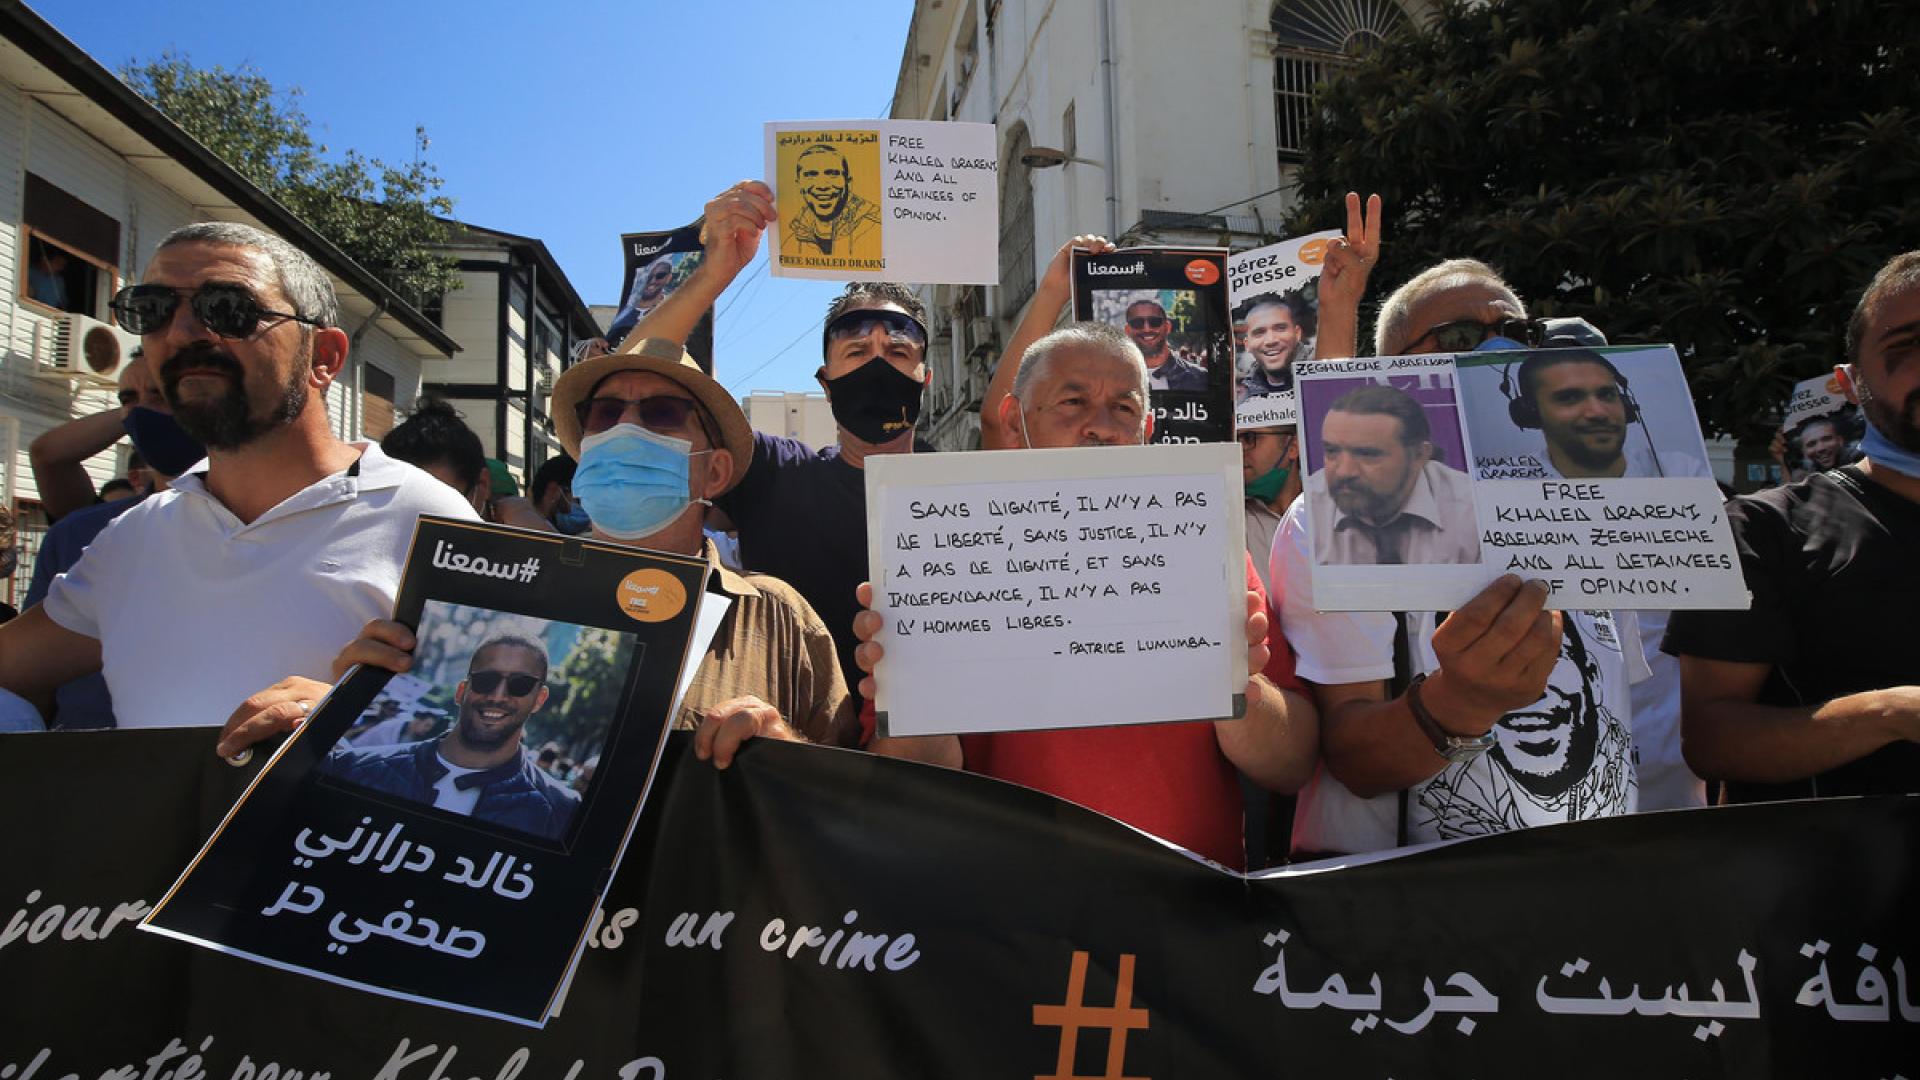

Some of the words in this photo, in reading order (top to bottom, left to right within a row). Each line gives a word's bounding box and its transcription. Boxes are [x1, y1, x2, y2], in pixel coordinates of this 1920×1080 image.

[889, 134, 925, 149] FREE
[888, 152, 945, 168] KHALED
[894, 169, 925, 183] AND
[931, 172, 958, 185] ALL
[888, 186, 954, 202] DETAINEES
[961, 192, 977, 202] OF
[893, 206, 947, 221] OPINION.
[778, 254, 804, 265] FREE
[805, 256, 846, 267] KHALED
[1231, 265, 1297, 293] presse
[1296, 360, 1382, 376] ZEGHILECHE
[1172, 401, 1209, 421] خالد
[1790, 396, 1831, 413] resse
[1475, 453, 1543, 469] KHALED
[1542, 482, 1605, 501] FREE
[909, 500, 971, 520] SANS
[988, 491, 1070, 519] DIGNITÉ,
[1076, 495, 1099, 513] IL
[1104, 493, 1142, 511] N'Y
[1145, 493, 1163, 509] A
[1174, 491, 1208, 508] PAS
[1495, 505, 1591, 523] KHALED
[896, 533, 921, 551] DE
[934, 525, 1015, 552] LIBERTÉ,
[1023, 528, 1068, 544] SANS
[1078, 526, 1145, 544] JUSTICE,
[1147, 522, 1170, 539] IL
[1173, 521, 1208, 536] N'Y
[1482, 529, 1580, 547] ABDELKRIM
[1590, 528, 1715, 548] ZEGHILECHE
[431, 539, 541, 584] #سمعنا
[896, 563, 912, 578] A
[922, 561, 956, 577] PAS
[969, 560, 993, 575] DE
[1006, 551, 1081, 575] DIGNITÉ,
[1086, 556, 1110, 570] ET
[1122, 553, 1166, 570] SANS
[1505, 553, 1552, 571] AND
[1564, 553, 1604, 570] ALL
[1616, 552, 1733, 571] DETAINEES
[887, 586, 1034, 608] INDEPENDANCE,
[1039, 585, 1060, 601] IL
[1064, 583, 1097, 599] N'Y
[1102, 582, 1119, 597] A
[1130, 580, 1162, 596] PAS
[1580, 578, 1690, 595] OPINION.
[922, 618, 992, 634] HOMMES
[1006, 615, 1073, 631] LIBRES.
[1068, 641, 1126, 655] PATRICE
[294, 816, 436, 873] درارني
[443, 852, 536, 901] خالد
[261, 879, 326, 918] حر
[327, 899, 487, 960] صحفي
[665, 909, 735, 951] un
[759, 910, 921, 972] crime
[1252, 928, 1499, 1037] جريمة
[1535, 948, 1761, 1042] ليست
